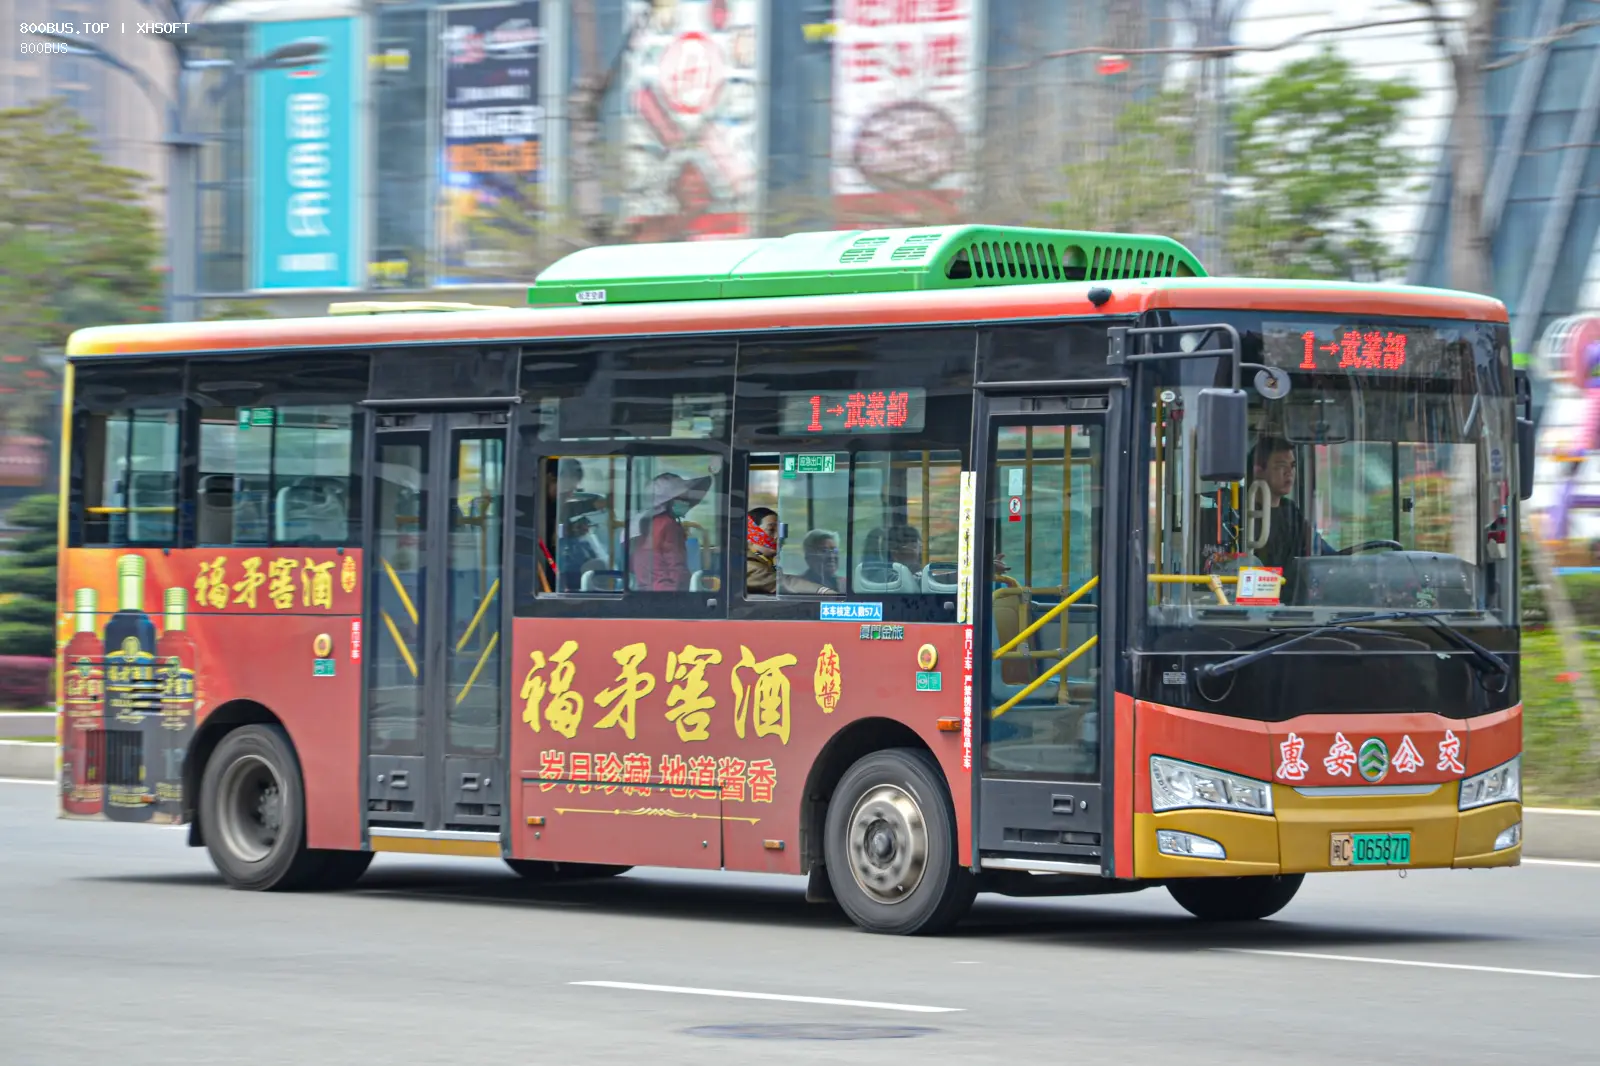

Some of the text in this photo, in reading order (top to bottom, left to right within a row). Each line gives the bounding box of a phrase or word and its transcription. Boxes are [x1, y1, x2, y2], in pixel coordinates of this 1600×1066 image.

[1299, 330, 1407, 370] 1 武装部
[807, 390, 909, 432] 1 武装部
[538, 749, 777, 803] 岁月珍藏 地道酱香
